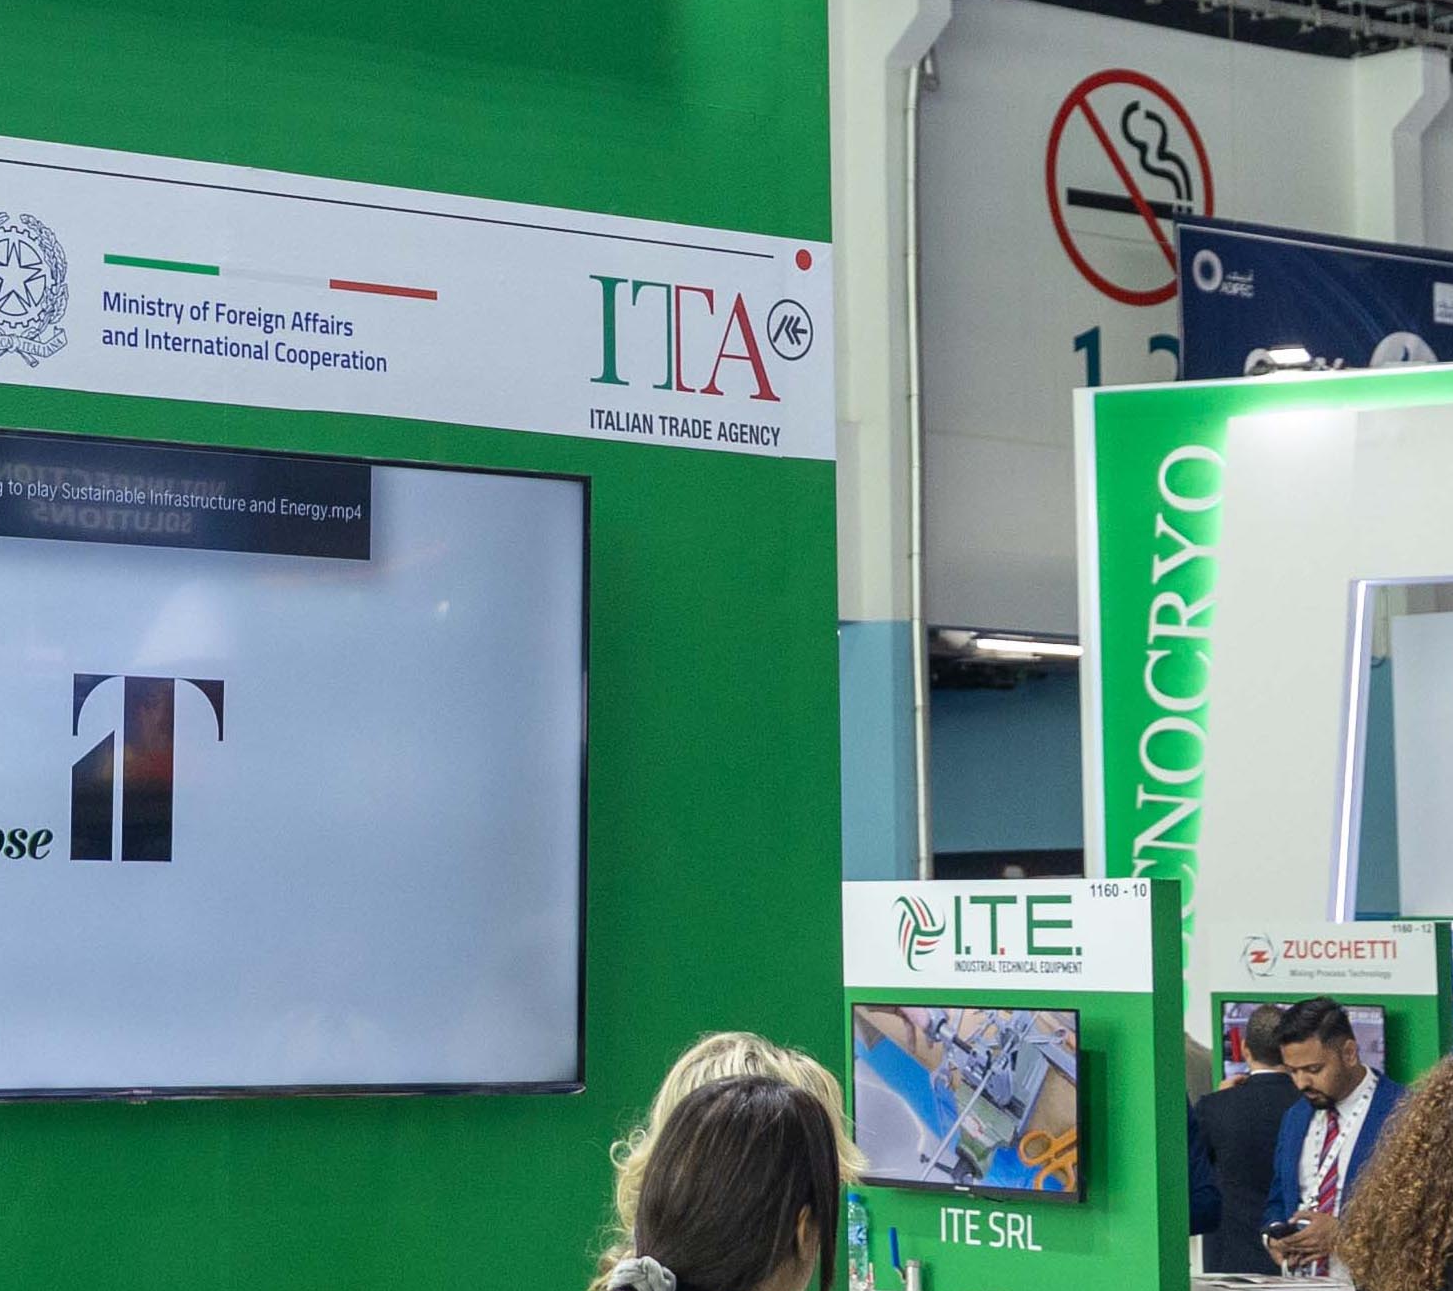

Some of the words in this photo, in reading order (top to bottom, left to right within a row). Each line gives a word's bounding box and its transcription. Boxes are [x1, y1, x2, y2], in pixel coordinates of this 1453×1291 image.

[103, 291, 184, 324] Ministry
[190, 301, 210, 322] of
[215, 303, 285, 335] Foreign
[291, 311, 354, 337] Affairs
[102, 327, 138, 348] and
[145, 328, 269, 361] International
[275, 342, 387, 372] Cooperation
[590, 408, 654, 435] ITALIAN
[658, 415, 713, 441] TRADE
[717, 421, 781, 448] AGENCY
[7, 479, 24, 496] to
[27, 480, 58, 501] play
[61, 482, 146, 506] Sustainable
[150, 489, 246, 512] Infrastructure
[249, 496, 276, 514] and
[280, 499, 363, 521] Energy.mp4
[1090, 883, 1119, 898] 1160
[1133, 883, 1148, 898] 10
[954, 895, 1082, 956] I.T.E.
[1392, 924, 1413, 934] 1160
[954, 960, 996, 974] INDUSTRIAL
[998, 960, 1038, 974] TECHNICAL
[1039, 960, 1083, 975] EQUIPMENT
[1283, 939, 1398, 960] ZUCCHETTI
[940, 1207, 982, 1245] ITE
[988, 1211, 1043, 1251] SRL
